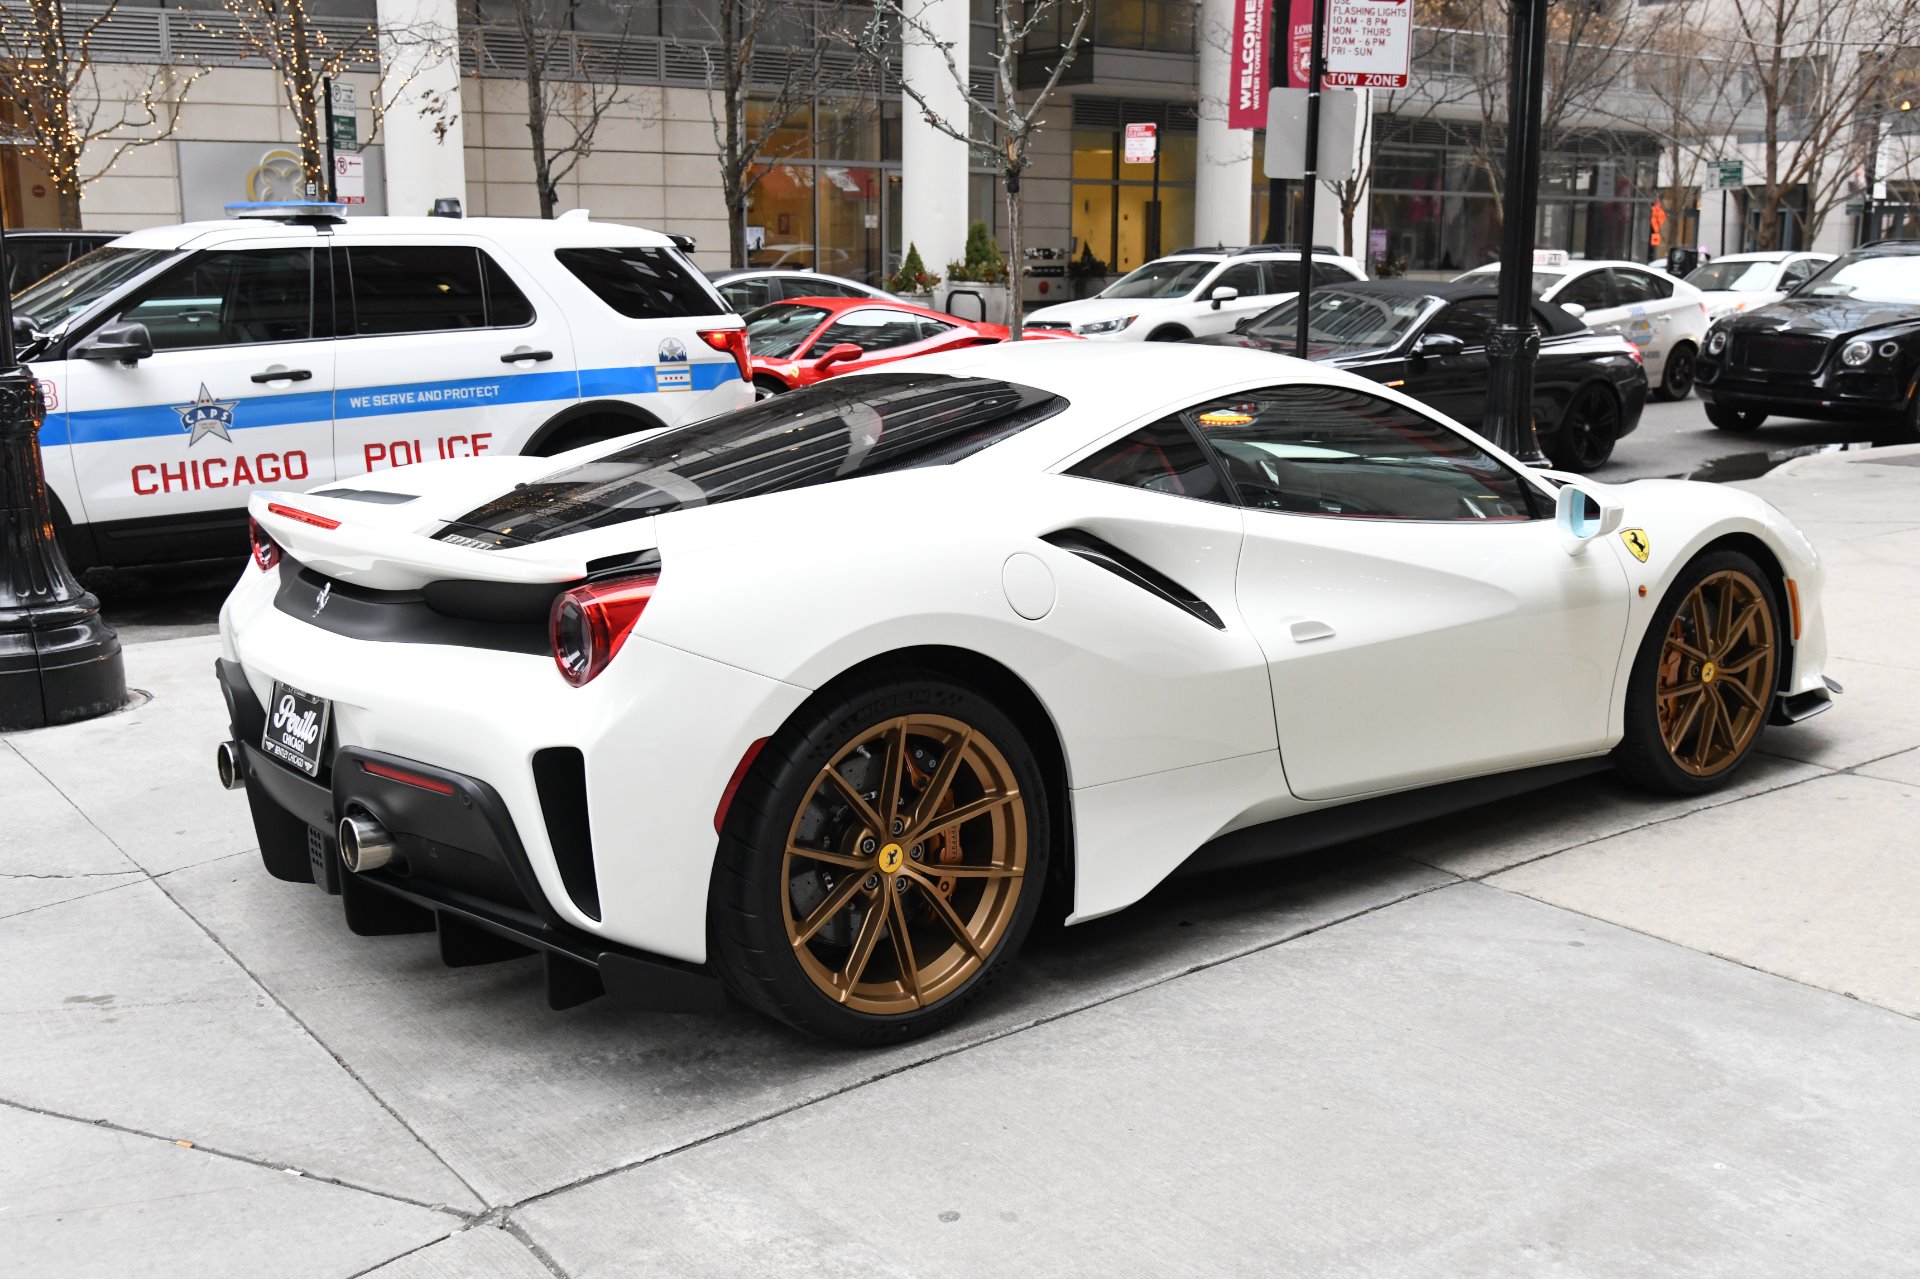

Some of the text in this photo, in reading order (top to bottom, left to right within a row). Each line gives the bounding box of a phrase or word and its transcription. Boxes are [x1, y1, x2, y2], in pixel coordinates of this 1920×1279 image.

[1256, 0, 1264, 40] CAMPUS
[1333, 7, 1407, 17] FLASHING LIGHTS
[1362, 28, 1391, 36] THURS
[1240, 0, 1256, 110] WELCOME
[1331, 47, 1345, 55] FRI
[1354, 47, 1373, 56] SUN
[1330, 73, 1400, 86] TOW ZONE
[350, 385, 500, 408] WE SERVE AND PROTECT
[185, 408, 229, 424] CAPS
[131, 450, 309, 495] CHICAGO
[274, 695, 318, 744] Perillo
[283, 732, 304, 753] CHICAGO
